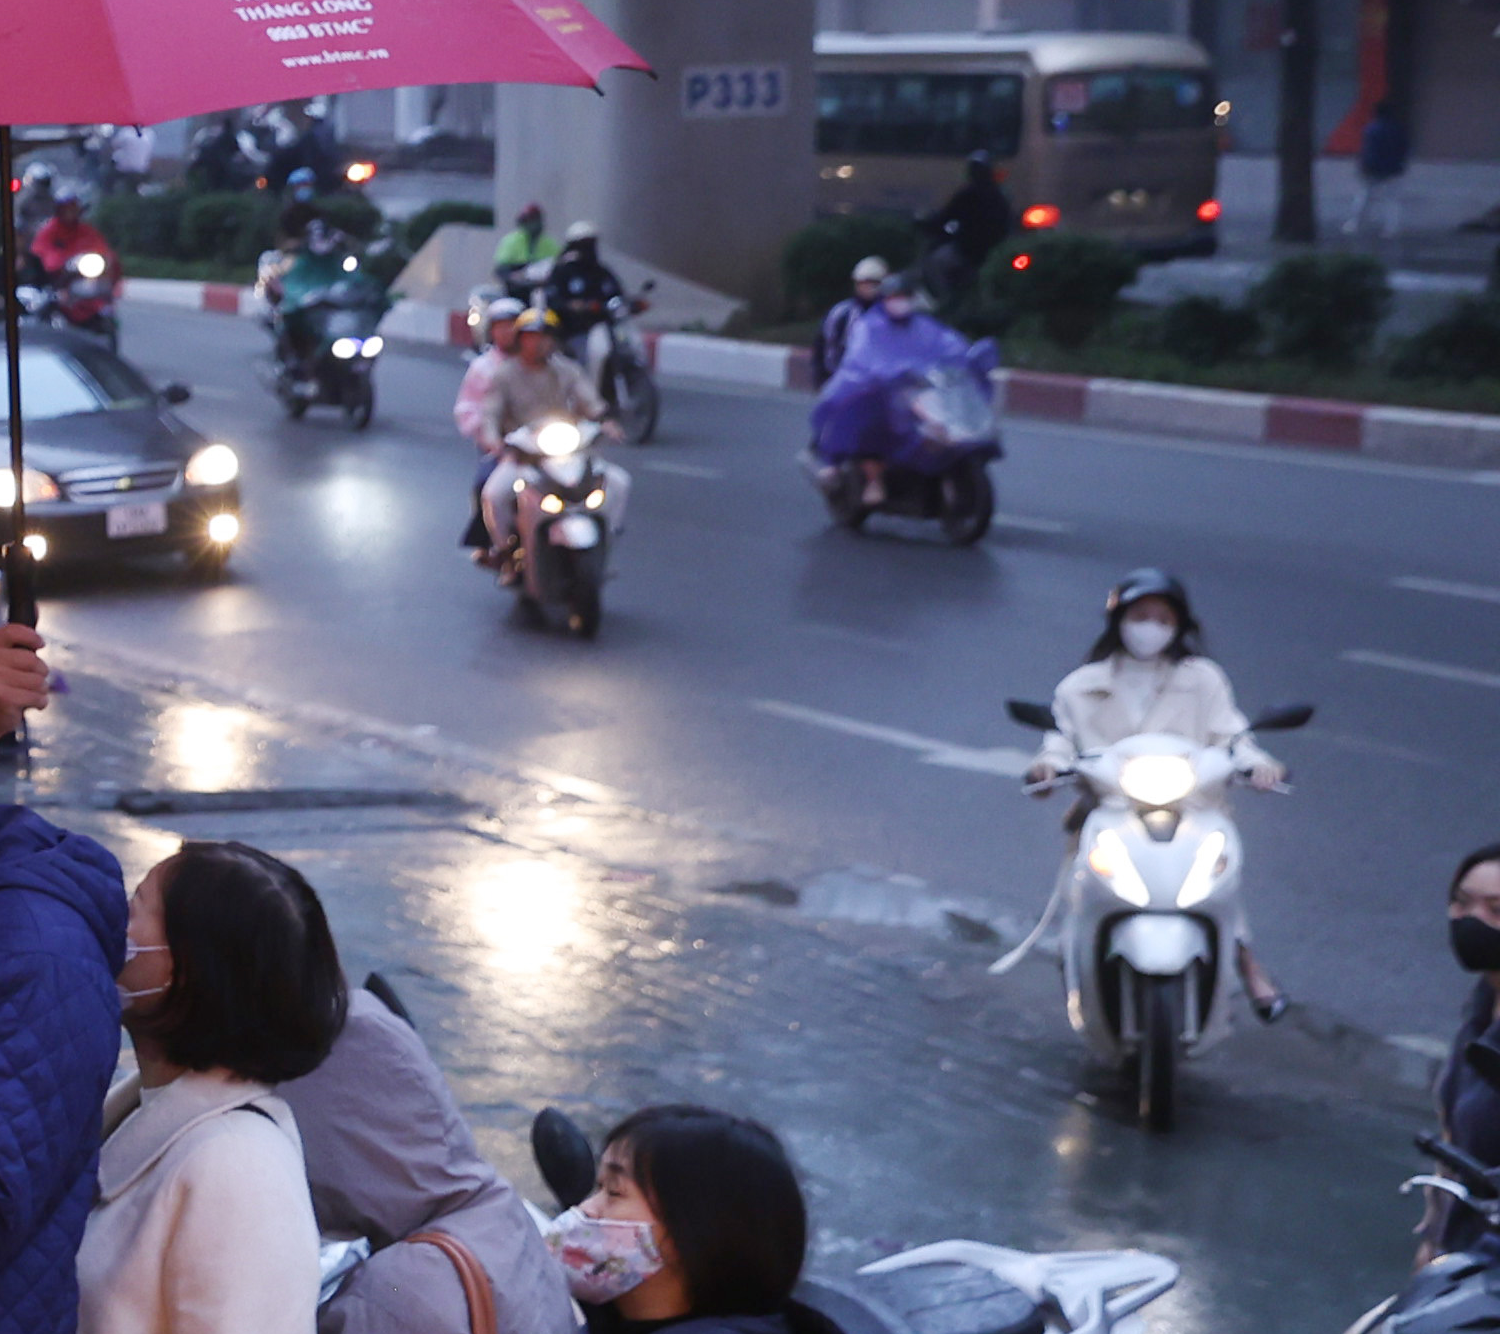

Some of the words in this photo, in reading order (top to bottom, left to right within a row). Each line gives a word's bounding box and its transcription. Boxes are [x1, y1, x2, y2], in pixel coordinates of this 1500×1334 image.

[233, 1, 311, 21] THĂNG
[281, 48, 390, 68] www.btmc.vn
[685, 73, 782, 111] P333
